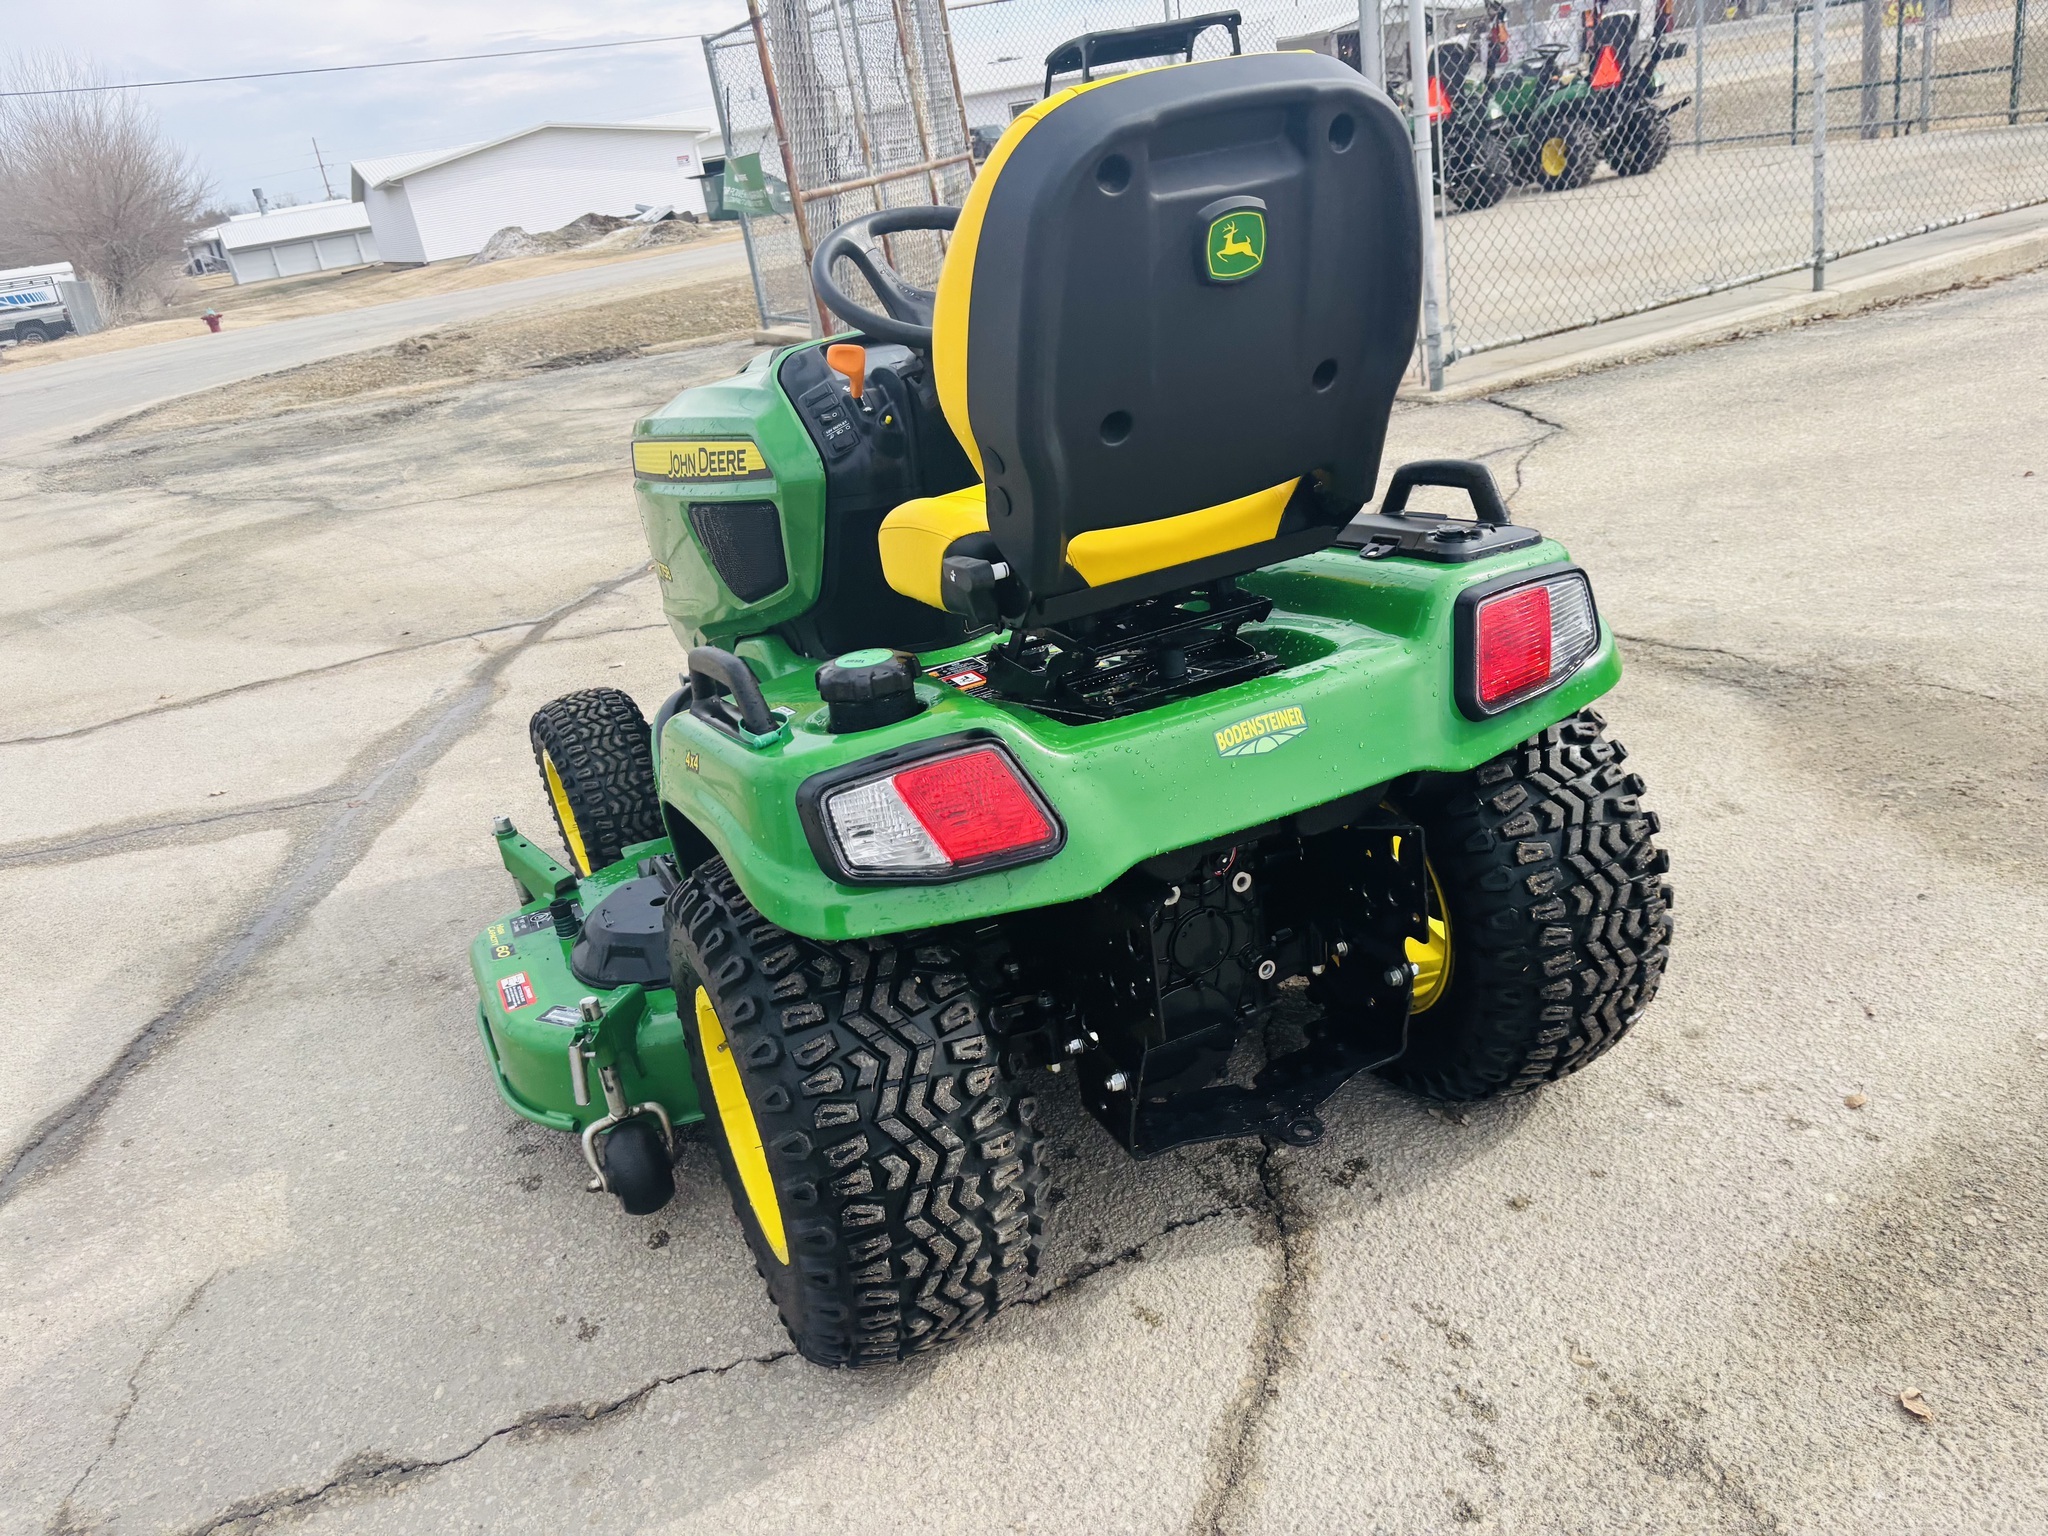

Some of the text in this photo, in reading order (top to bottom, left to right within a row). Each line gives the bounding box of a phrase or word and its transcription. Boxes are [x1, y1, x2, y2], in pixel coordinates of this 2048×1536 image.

[668, 447, 747, 476] JOHN DEERE
[1215, 706, 1306, 752] BODENSTEINER
[495, 945, 511, 958] 60
